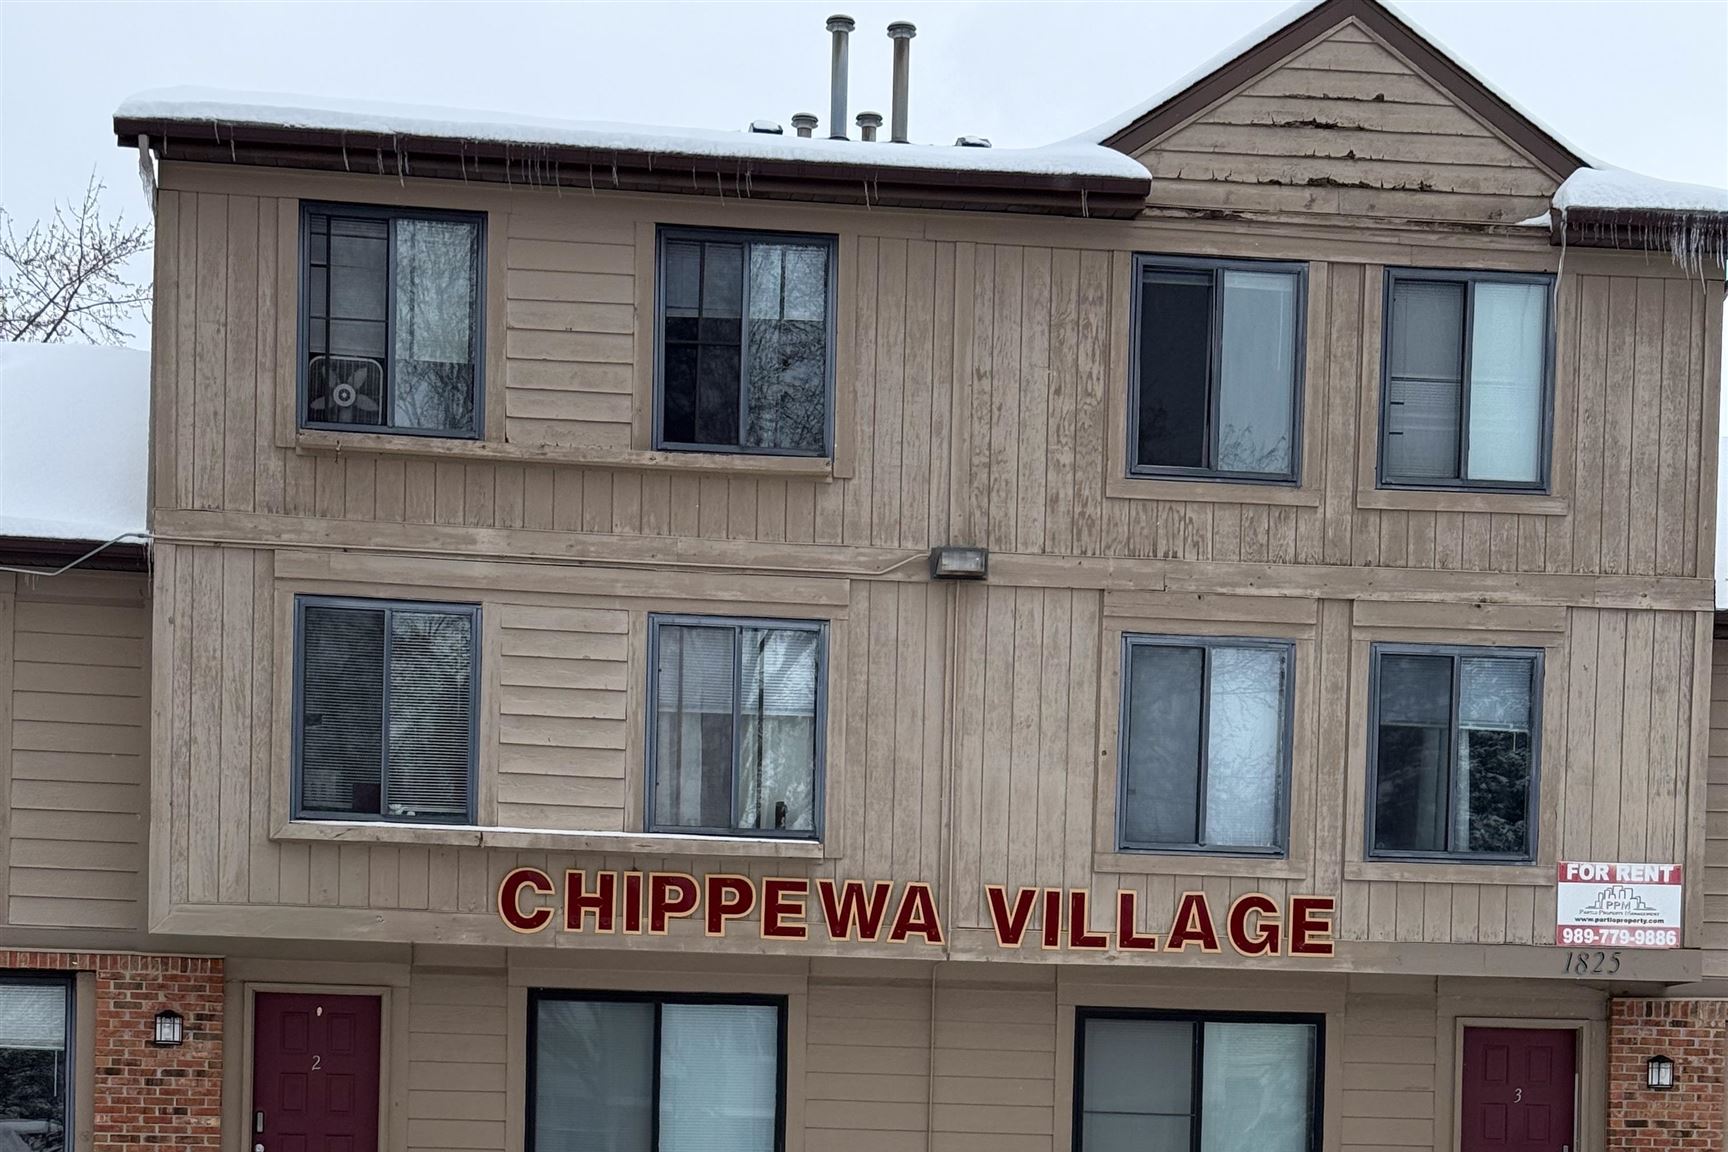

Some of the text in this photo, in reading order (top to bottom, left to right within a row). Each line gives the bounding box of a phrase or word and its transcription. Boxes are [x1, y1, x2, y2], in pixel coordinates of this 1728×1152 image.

[1566, 864, 1673, 882] FOR RENT
[498, 867, 1336, 958] CHIPPEWA VILLAGE
[1606, 901, 1631, 910] PPM
[1563, 928, 1677, 945] 989-779-9886
[1562, 951, 1621, 974] 1825
[311, 1055, 321, 1071] 2
[1513, 1088, 1522, 1104] 3
